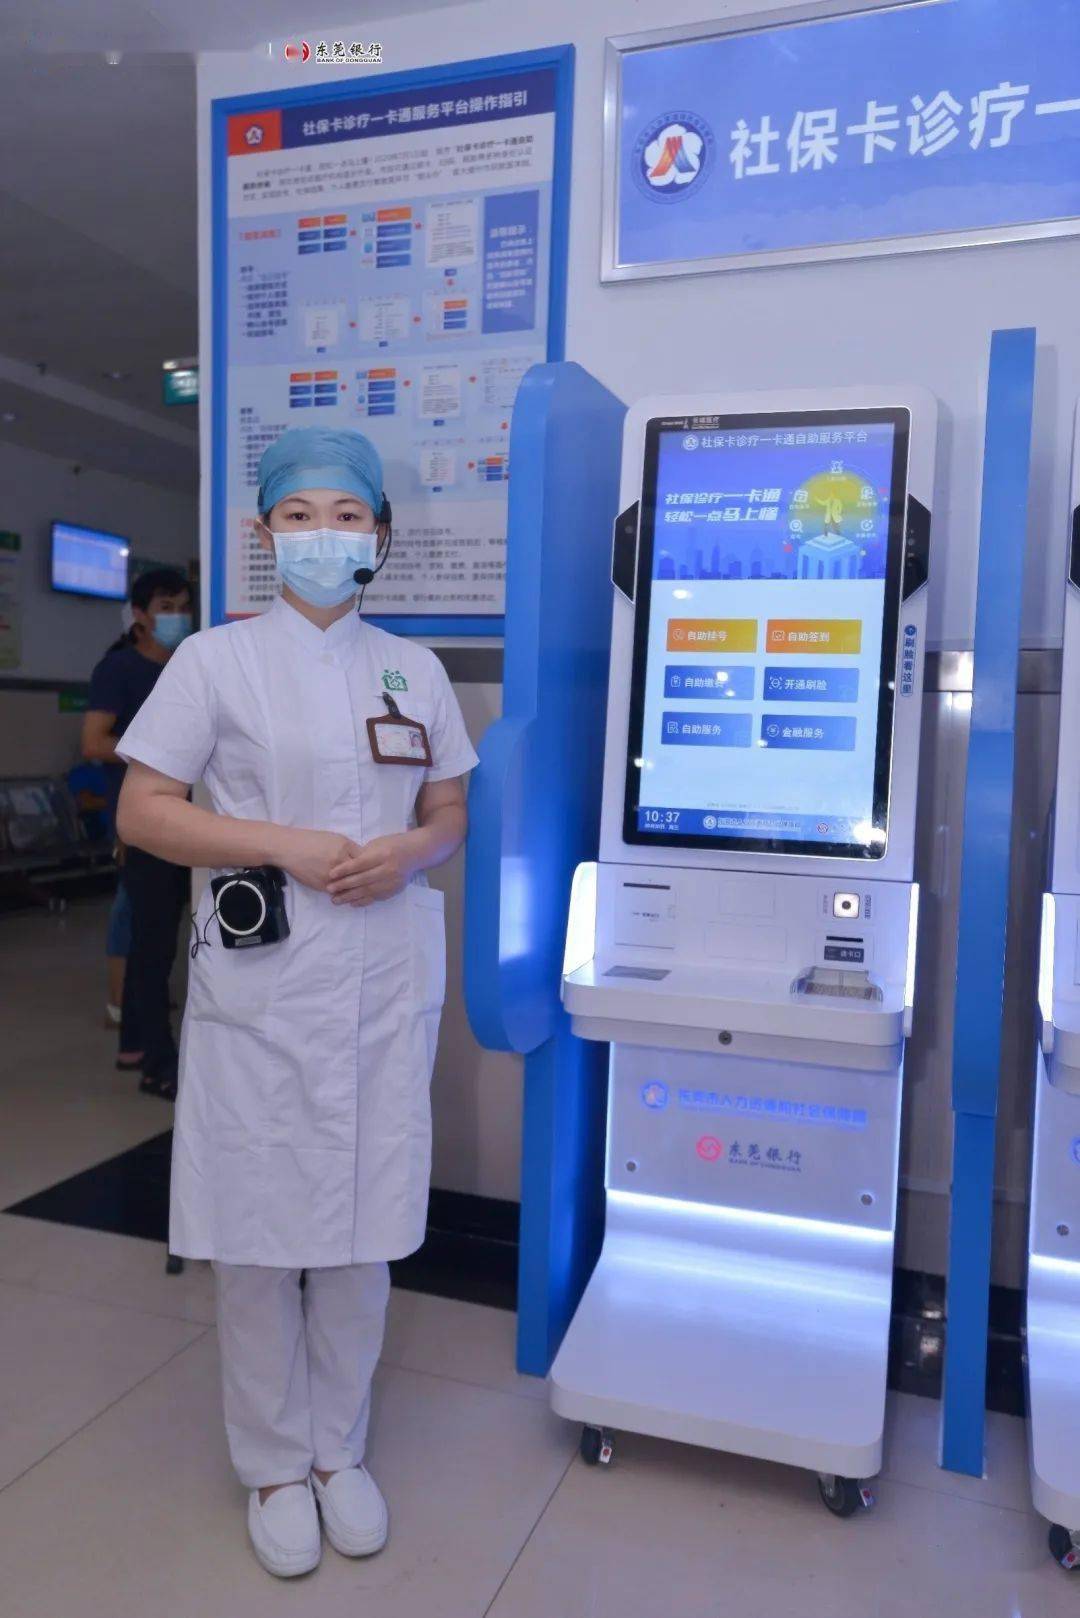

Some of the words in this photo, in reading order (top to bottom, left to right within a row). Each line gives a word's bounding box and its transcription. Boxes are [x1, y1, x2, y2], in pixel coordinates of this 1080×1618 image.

[303, 90, 528, 136] 社保卡诊疗一卡通服务平台操作指引
[728, 81, 1080, 179] 社保卡诊疗一
[701, 431, 868, 449] 社保卡诊疗一卡通自助服务平台
[665, 488, 782, 505] 社保诊疗一卡通
[687, 629, 728, 642] 自助挂号
[787, 631, 830, 643] 自助签到
[784, 679, 828, 691] 开通刷脸
[682, 724, 722, 736] 自助服务
[782, 727, 825, 739] 金融服务
[644, 810, 681, 823] 10:37
[728, 1140, 802, 1165] 东莞银行
